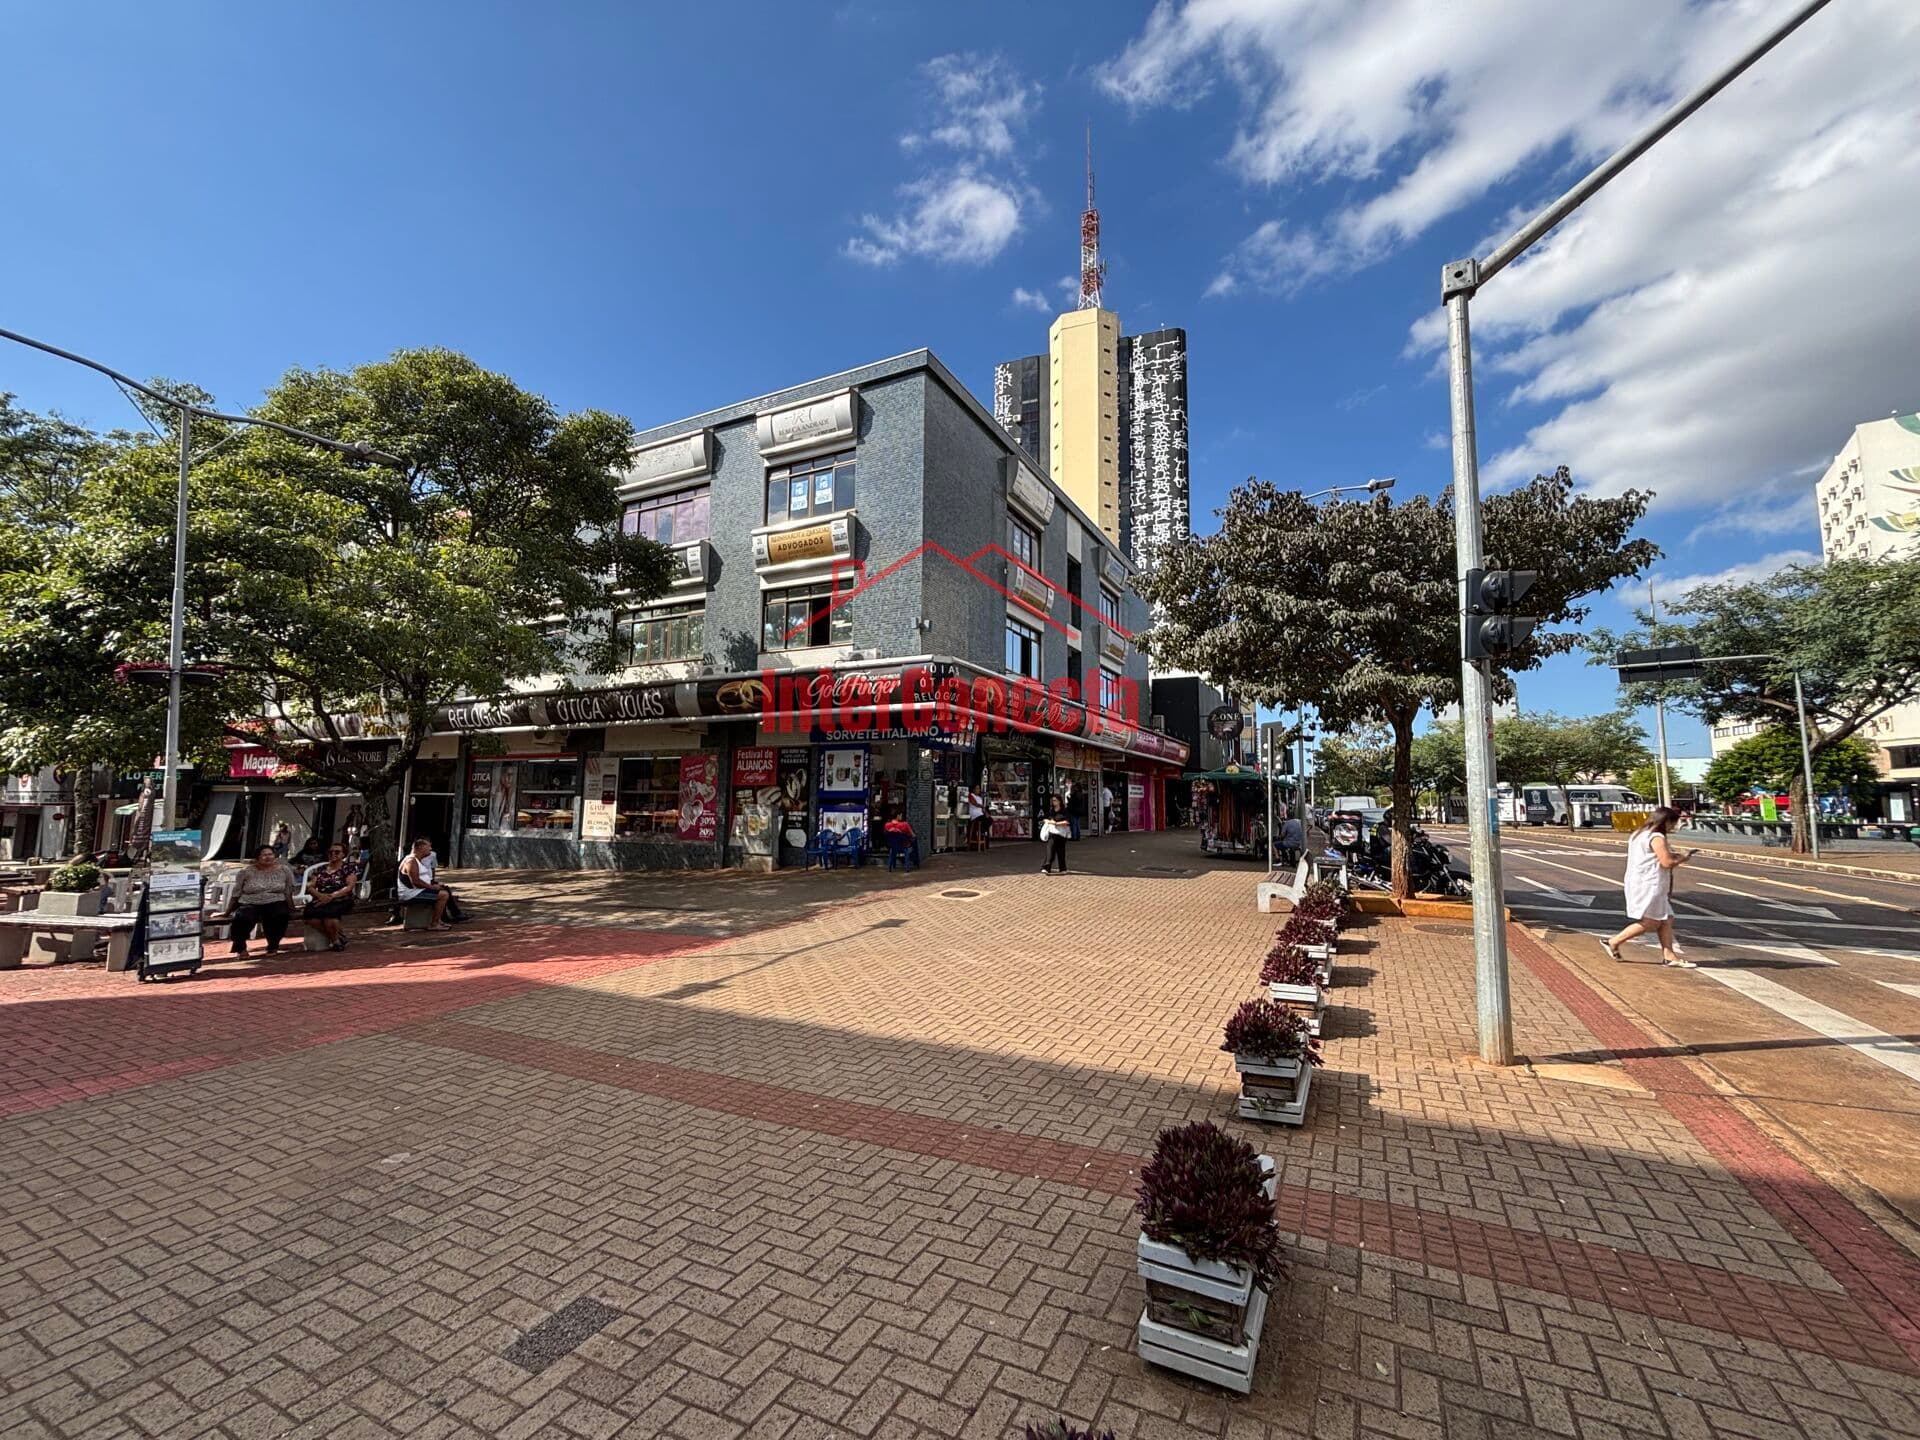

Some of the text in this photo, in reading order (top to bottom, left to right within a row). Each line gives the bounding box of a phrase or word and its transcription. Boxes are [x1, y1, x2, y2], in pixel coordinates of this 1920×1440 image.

[777, 536, 825, 552] ADVOGADOS
[1211, 712, 1241, 721] ZONE
[826, 725, 940, 741] SORVETE ITALIANO
[357, 751, 383, 763] STORE
[737, 749, 764, 759] Festival
[765, 749, 774, 759] de
[736, 759, 774, 774] ALIANÇAS
